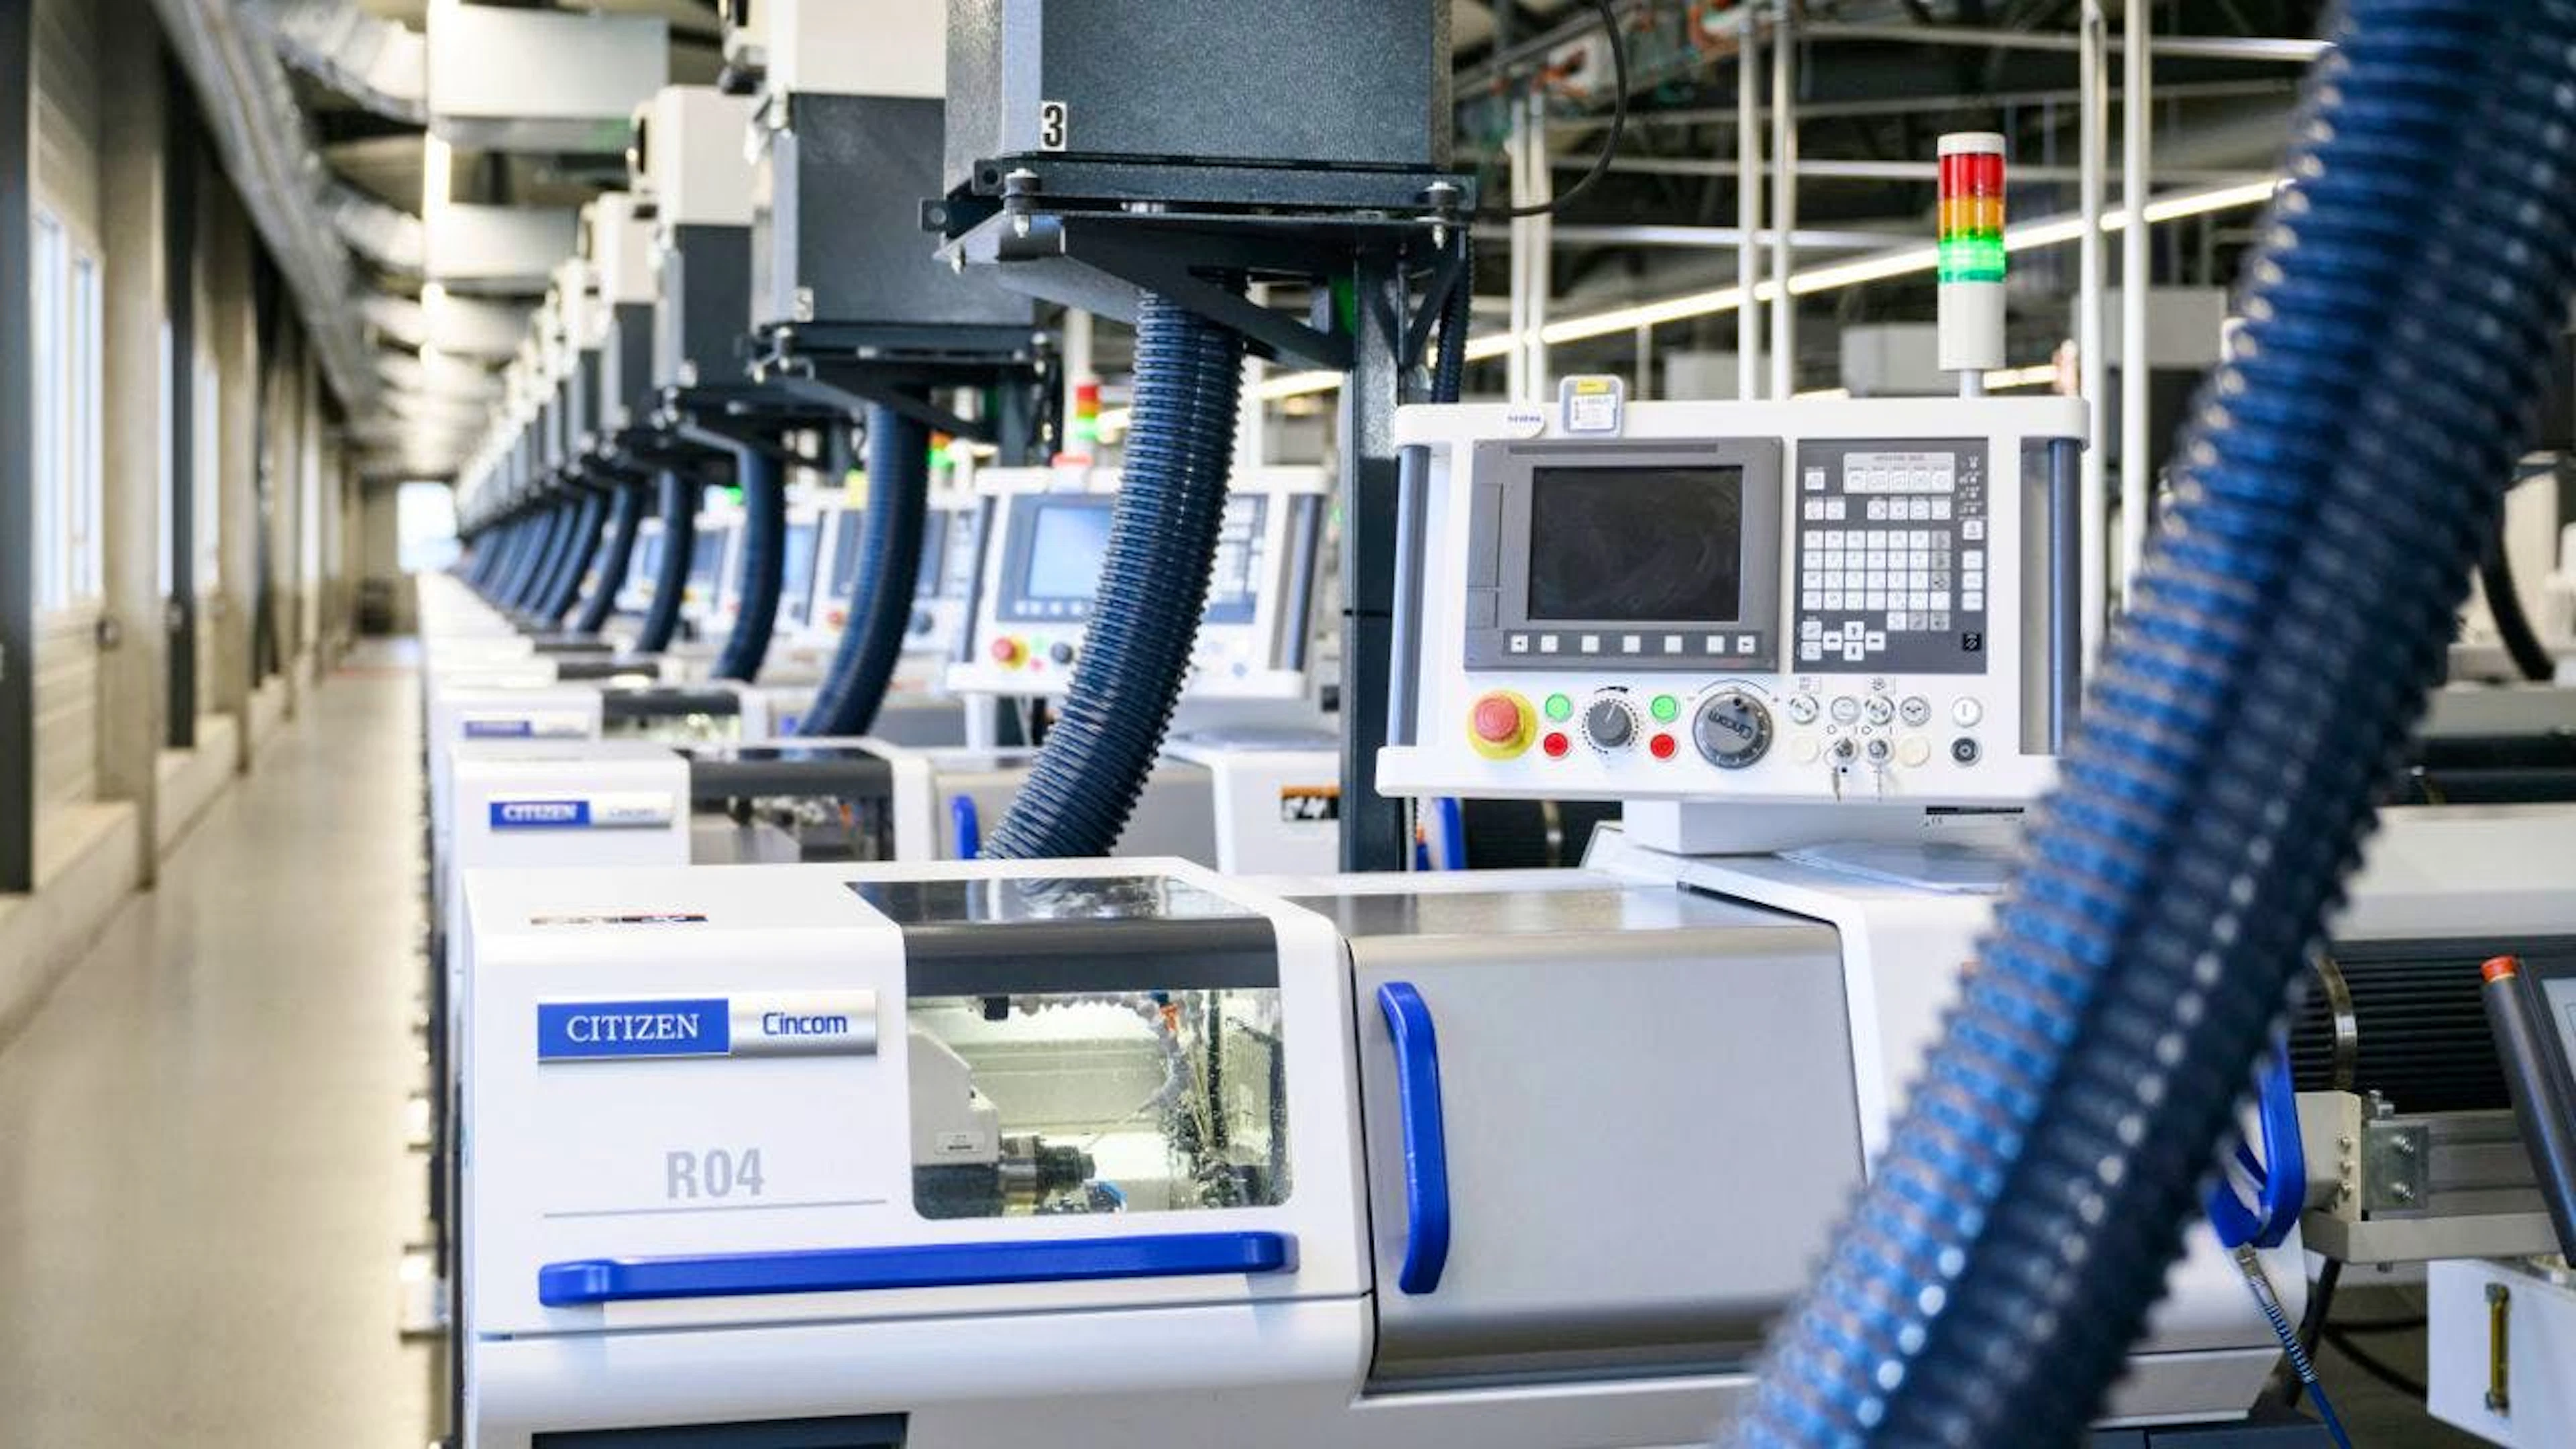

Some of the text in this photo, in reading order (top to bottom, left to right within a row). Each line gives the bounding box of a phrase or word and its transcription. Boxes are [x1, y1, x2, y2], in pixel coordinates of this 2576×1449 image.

[1044, 105, 1063, 147] 3
[566, 1011, 848, 1042] CITIZEN Cincom
[665, 1148, 765, 1199] R04
